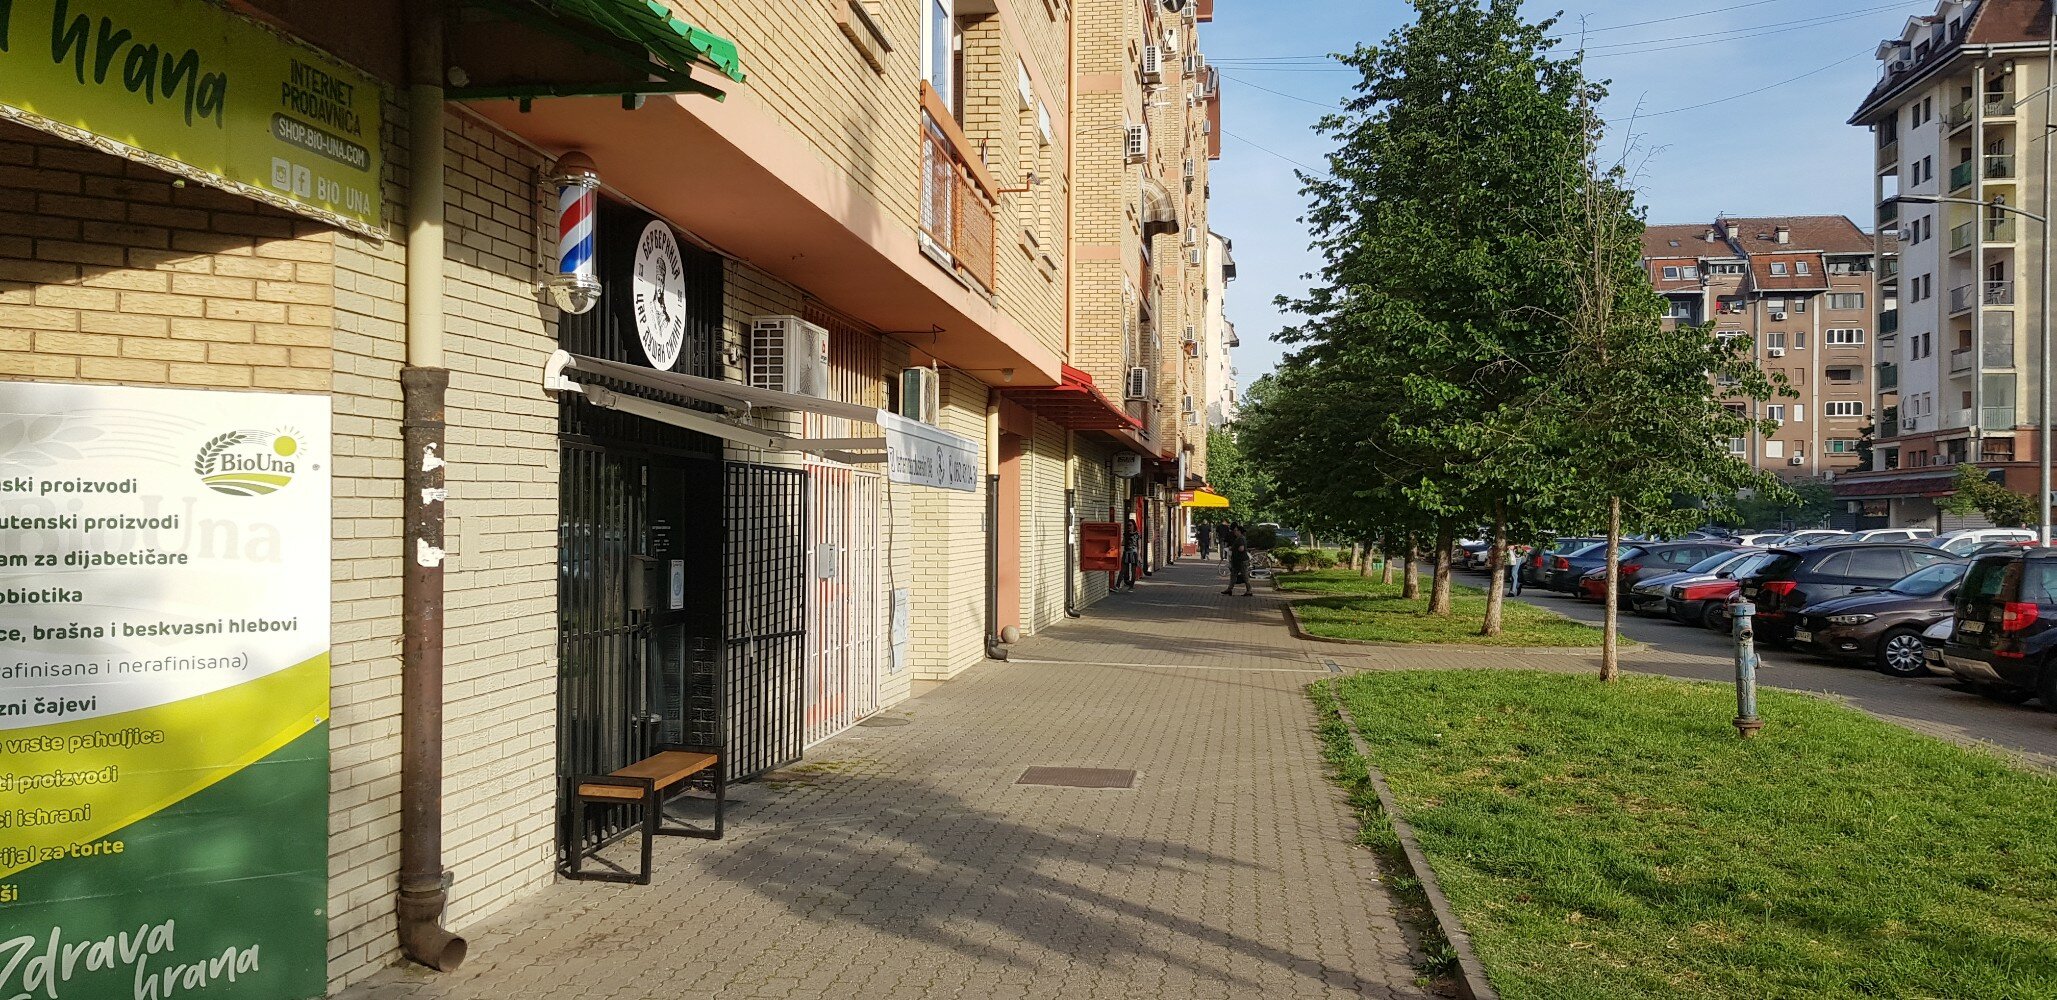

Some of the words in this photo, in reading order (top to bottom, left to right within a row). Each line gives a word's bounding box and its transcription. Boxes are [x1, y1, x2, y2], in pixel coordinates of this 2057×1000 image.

[51, 0, 227, 129] hrana
[290, 58, 354, 108] INTERNET
[281, 81, 363, 138] PRODAVNICA
[346, 186, 371, 216] UNA
[636, 293, 647, 324] ЦАР
[220, 453, 296, 474] BioUna
[0, 476, 33, 492] ski
[41, 477, 137, 496] proizvodi
[84, 513, 179, 533] proizvodi
[34, 554, 58, 567] za
[64, 549, 188, 569] dijabetičare
[33, 622, 104, 641] brašna
[110, 622, 117, 638] i
[122, 618, 223, 638] beskvasni
[228, 616, 298, 634] hlebovi
[0, 661, 99, 679] afinisana
[106, 660, 111, 674] i
[118, 651, 250, 674] nerafinisana)
[33, 695, 97, 717] čajevi
[6, 735, 65, 754] vrste
[68, 728, 165, 754] pahuljica
[18, 765, 119, 794] proizvodi
[16, 803, 91, 828] ishrani
[0, 845, 37, 868] ijal
[40, 846, 66, 862] za
[70, 840, 125, 859] torte
[0, 883, 19, 903] ši
[0, 919, 175, 999] Zdrava
[134, 943, 260, 1000] hrana
